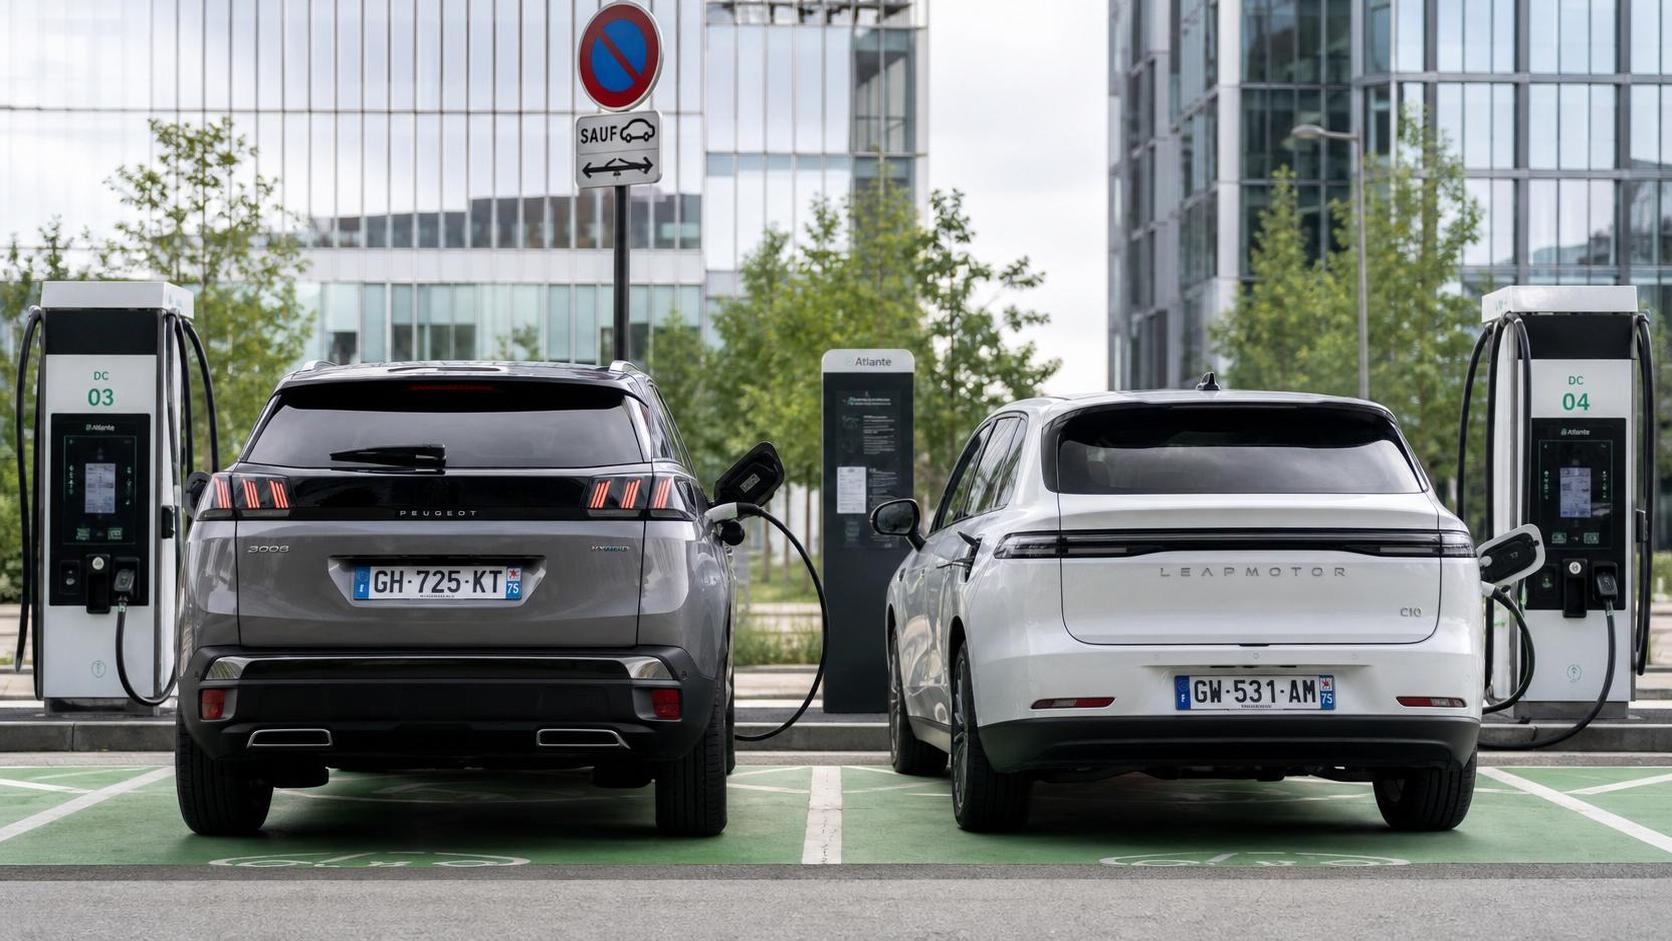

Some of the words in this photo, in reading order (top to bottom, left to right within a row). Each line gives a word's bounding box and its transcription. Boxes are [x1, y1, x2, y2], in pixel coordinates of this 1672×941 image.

[580, 125, 618, 144] SAUF
[855, 356, 892, 367] Atlante
[93, 371, 109, 381] DC
[1568, 375, 1584, 386] DC
[87, 387, 114, 406] 03
[1562, 392, 1590, 411] 04
[1160, 566, 1346, 577] LEAPMOTOR
[1400, 607, 1422, 618] C10
[1321, 693, 1333, 704] 75
